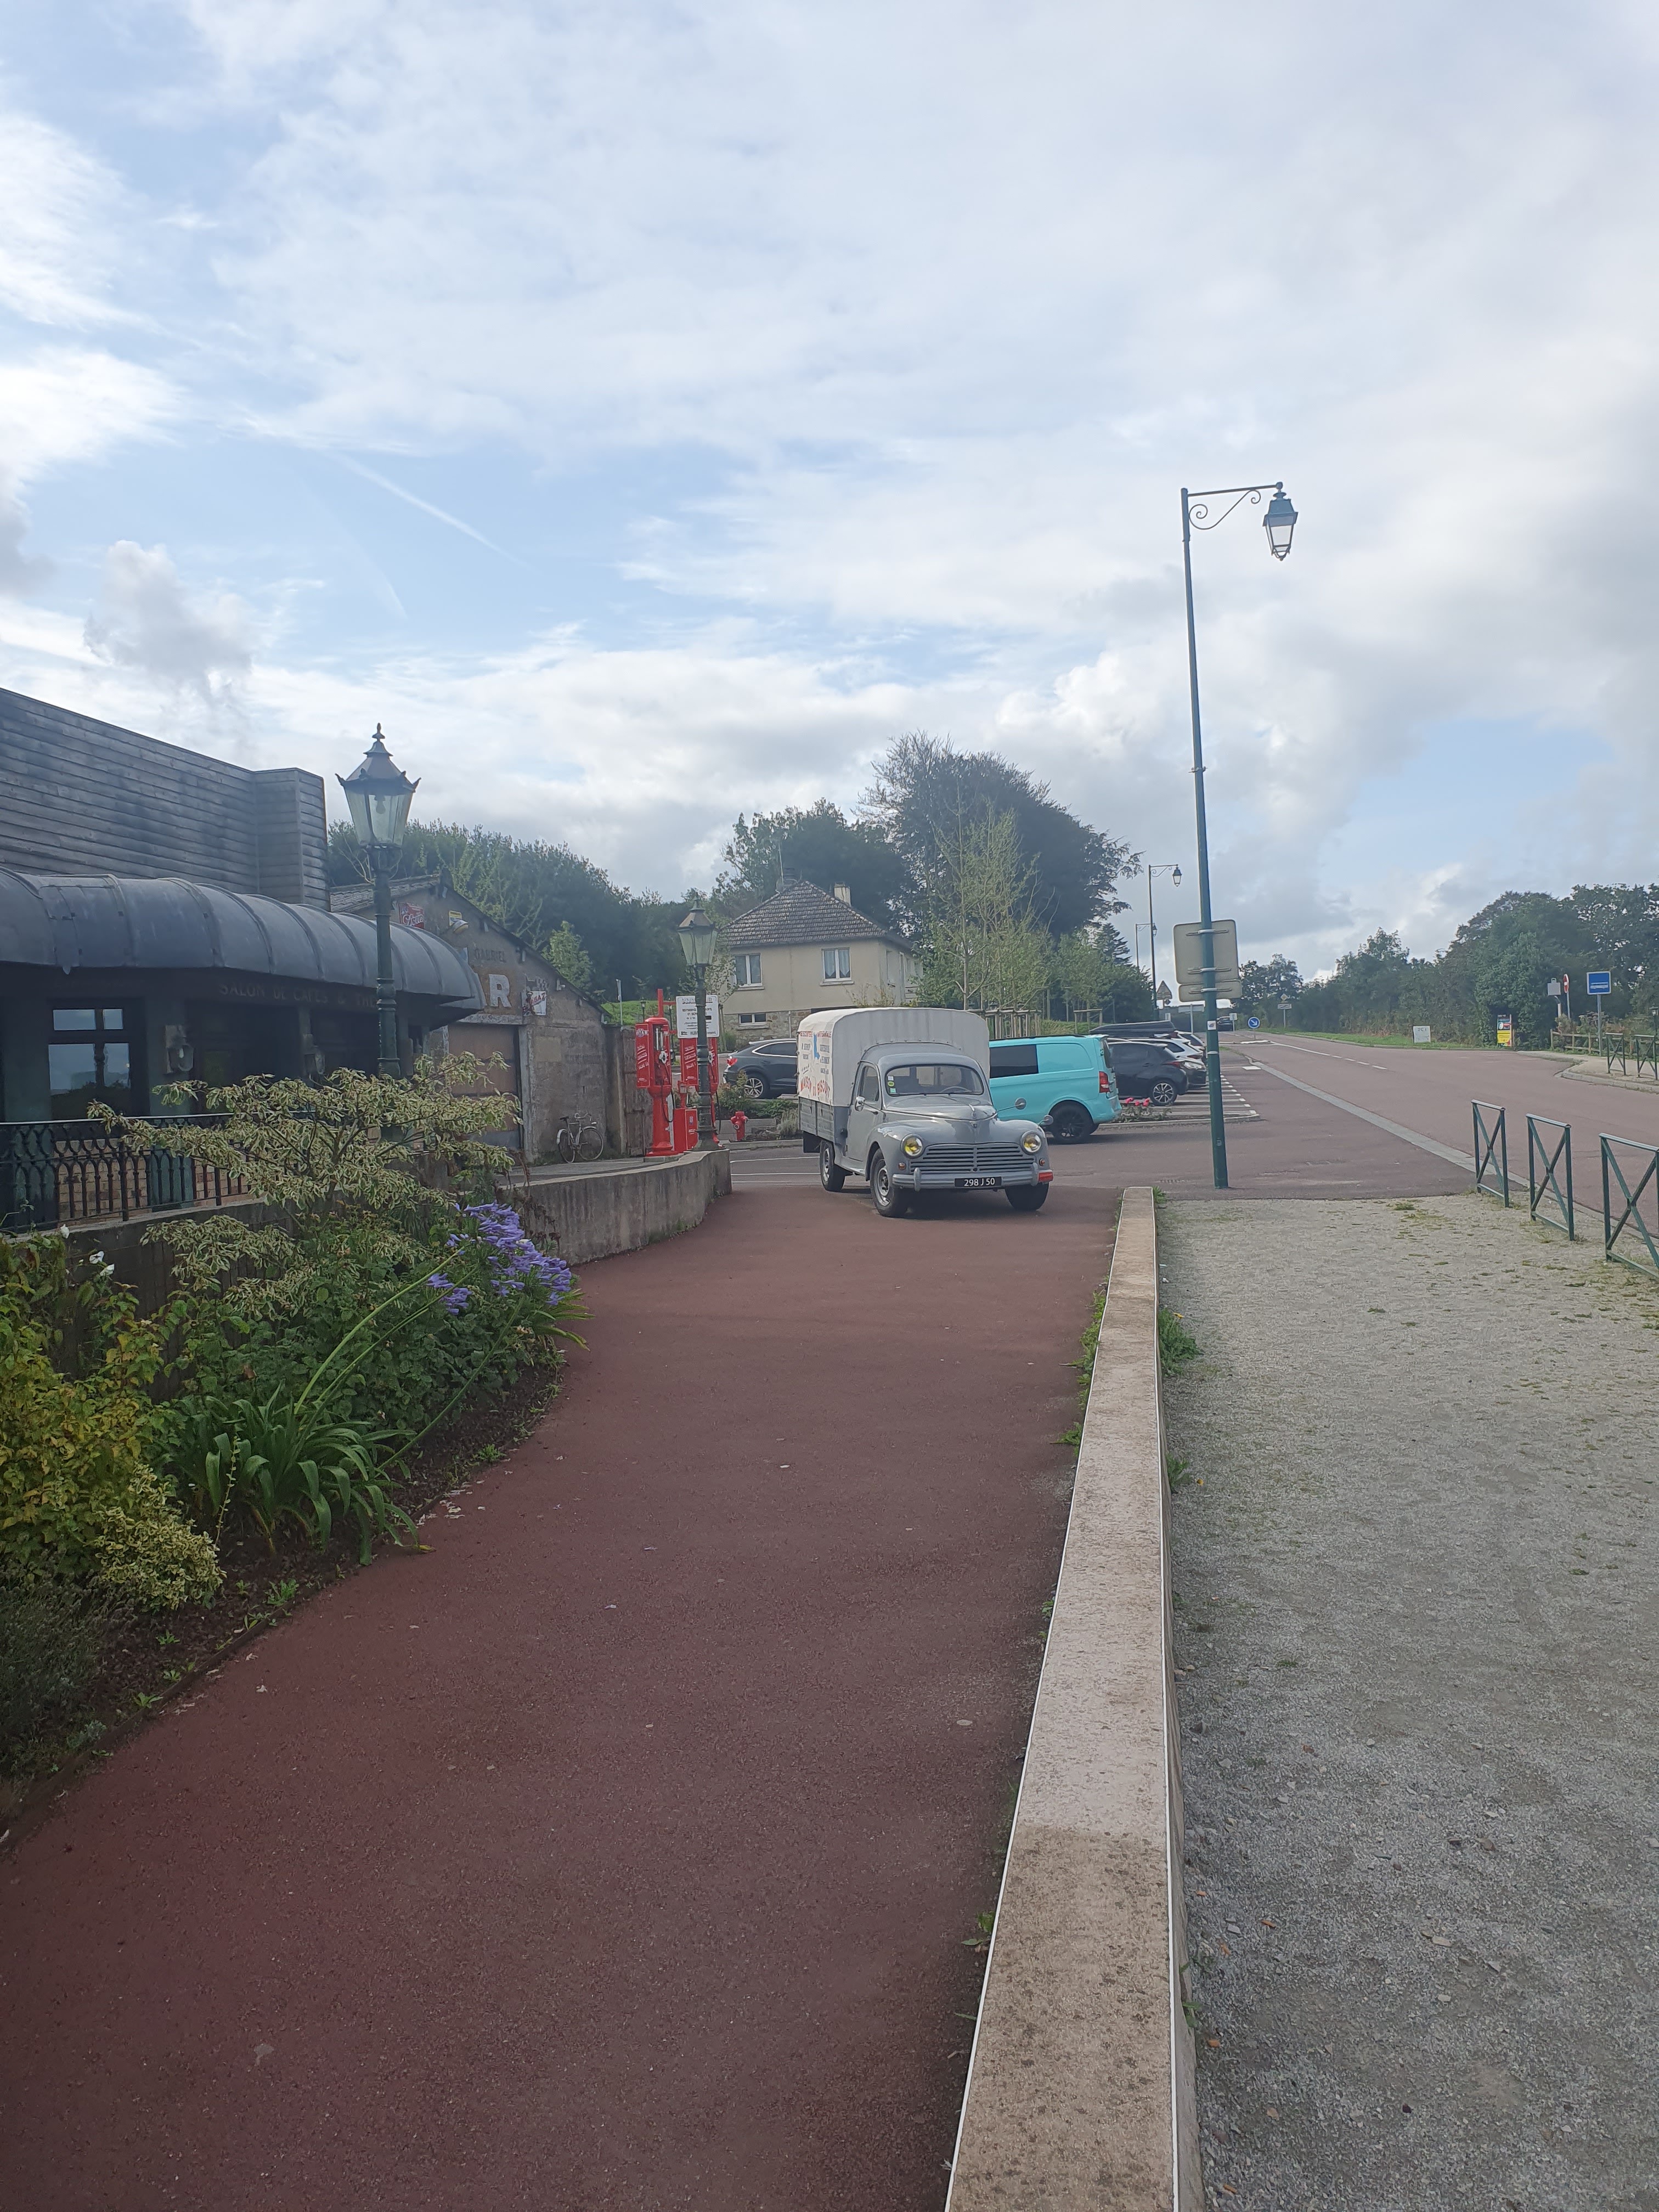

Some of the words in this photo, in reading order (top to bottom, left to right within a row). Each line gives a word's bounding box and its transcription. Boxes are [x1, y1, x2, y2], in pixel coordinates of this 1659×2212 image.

[219, 981, 265, 997] SALON
[817, 1079, 831, 1098] BISCUIT
[964, 1178, 979, 1187] 298
[980, 1178, 984, 1186] J
[985, 1177, 995, 1186] 50
